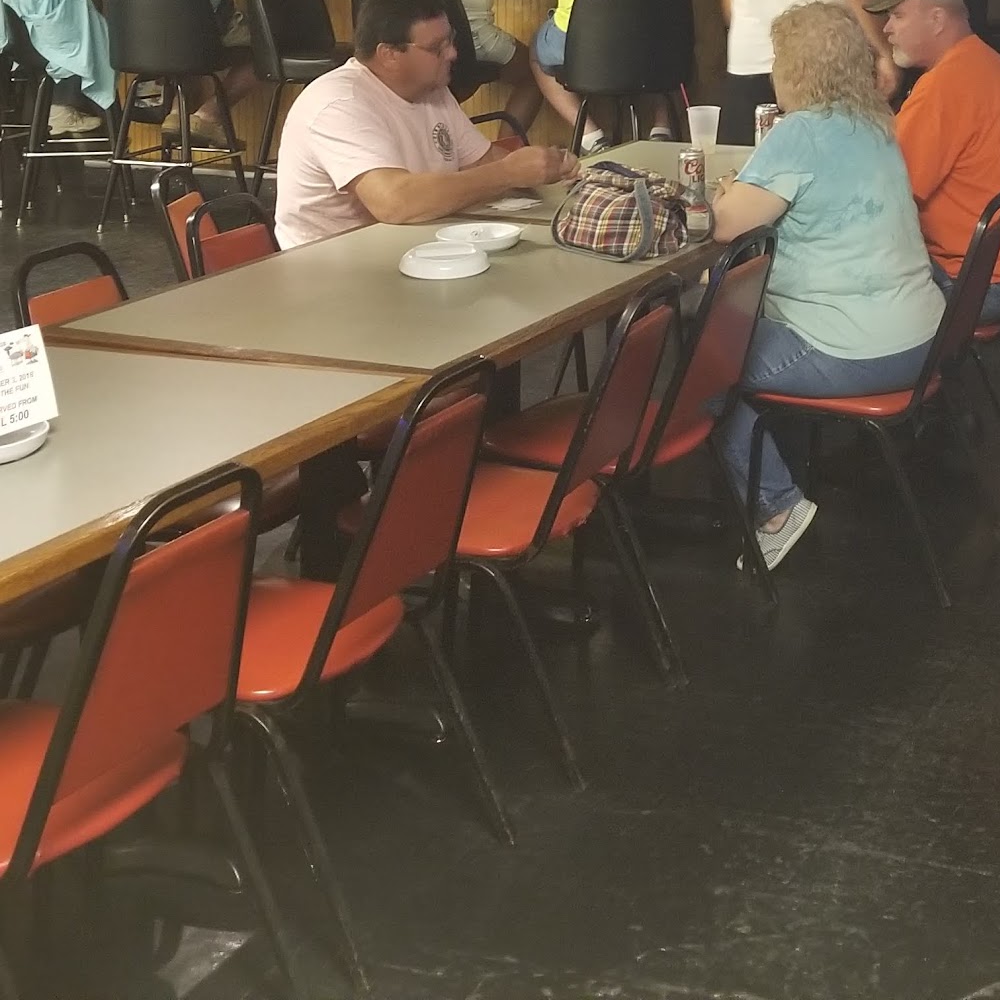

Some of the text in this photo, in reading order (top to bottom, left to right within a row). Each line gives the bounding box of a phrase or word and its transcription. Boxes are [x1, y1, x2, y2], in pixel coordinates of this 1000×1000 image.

[1, 383, 29, 397] THE FUN
[18, 396, 38, 408] FROM
[10, 409, 30, 424] 5:00
